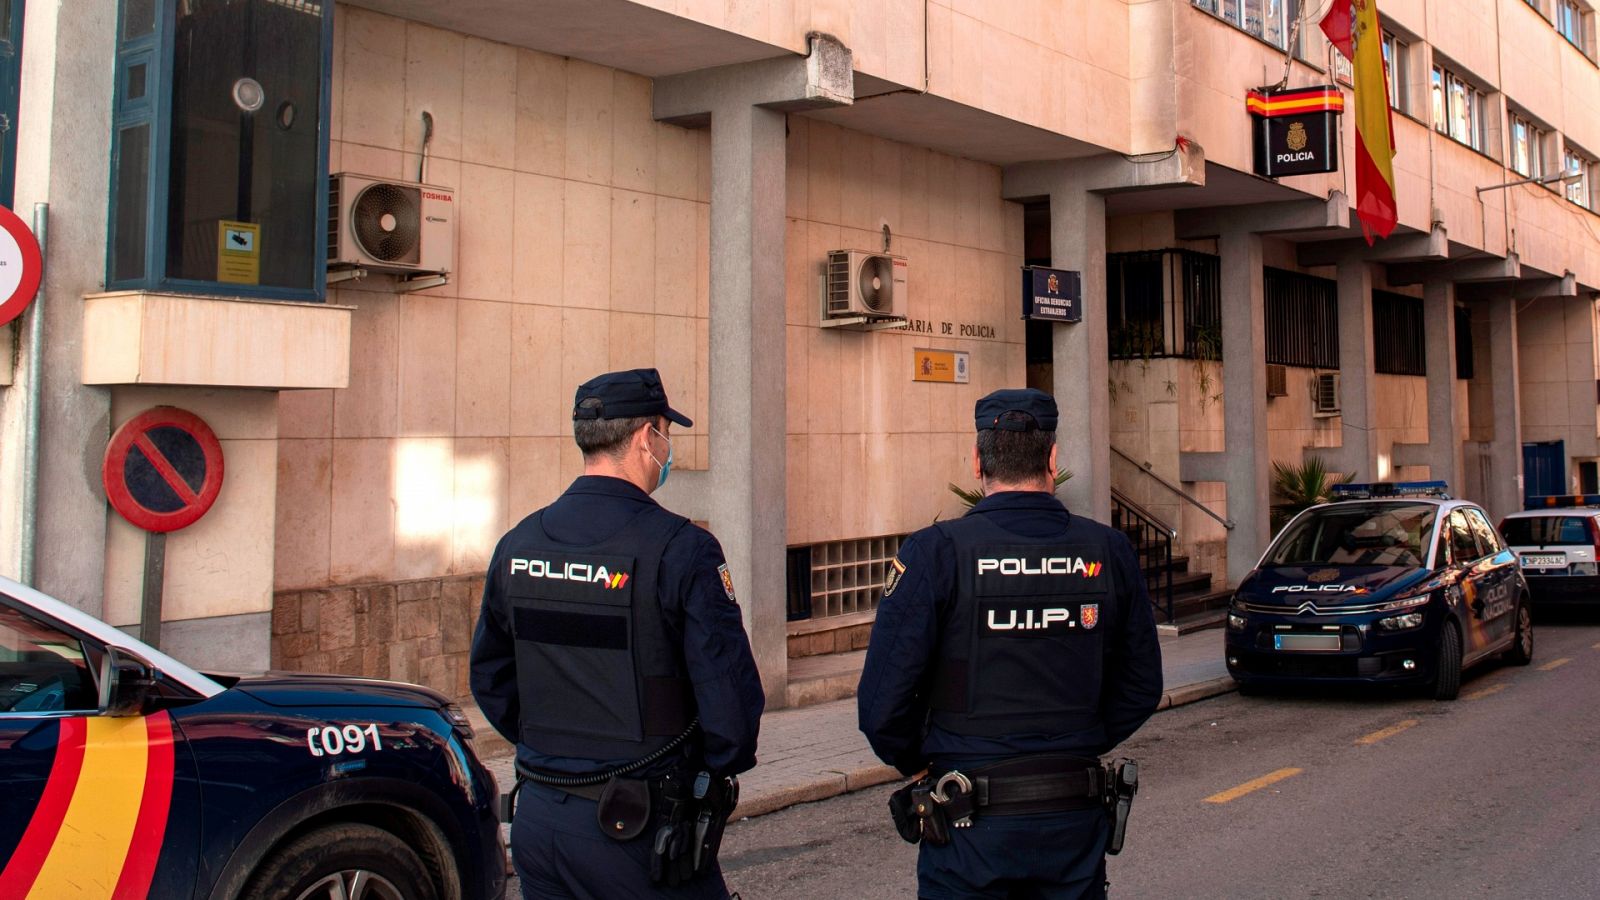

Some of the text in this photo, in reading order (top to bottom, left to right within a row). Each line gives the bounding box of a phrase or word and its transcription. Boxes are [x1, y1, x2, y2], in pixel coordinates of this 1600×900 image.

[1277, 152, 1314, 163] POLICIA
[422, 192, 452, 202] TOSHIBA
[1034, 296, 1072, 307] OFICINA DENUNCIAS
[1040, 306, 1067, 316] EXTRANJEROS
[941, 321, 953, 335] DE
[960, 324, 996, 339] POLICIA
[511, 558, 611, 583] POLICIA
[977, 557, 1087, 575] POLICIA
[1271, 584, 1357, 593] POLICIA
[987, 608, 1076, 630] U.I.P.
[321, 723, 382, 755] 091
